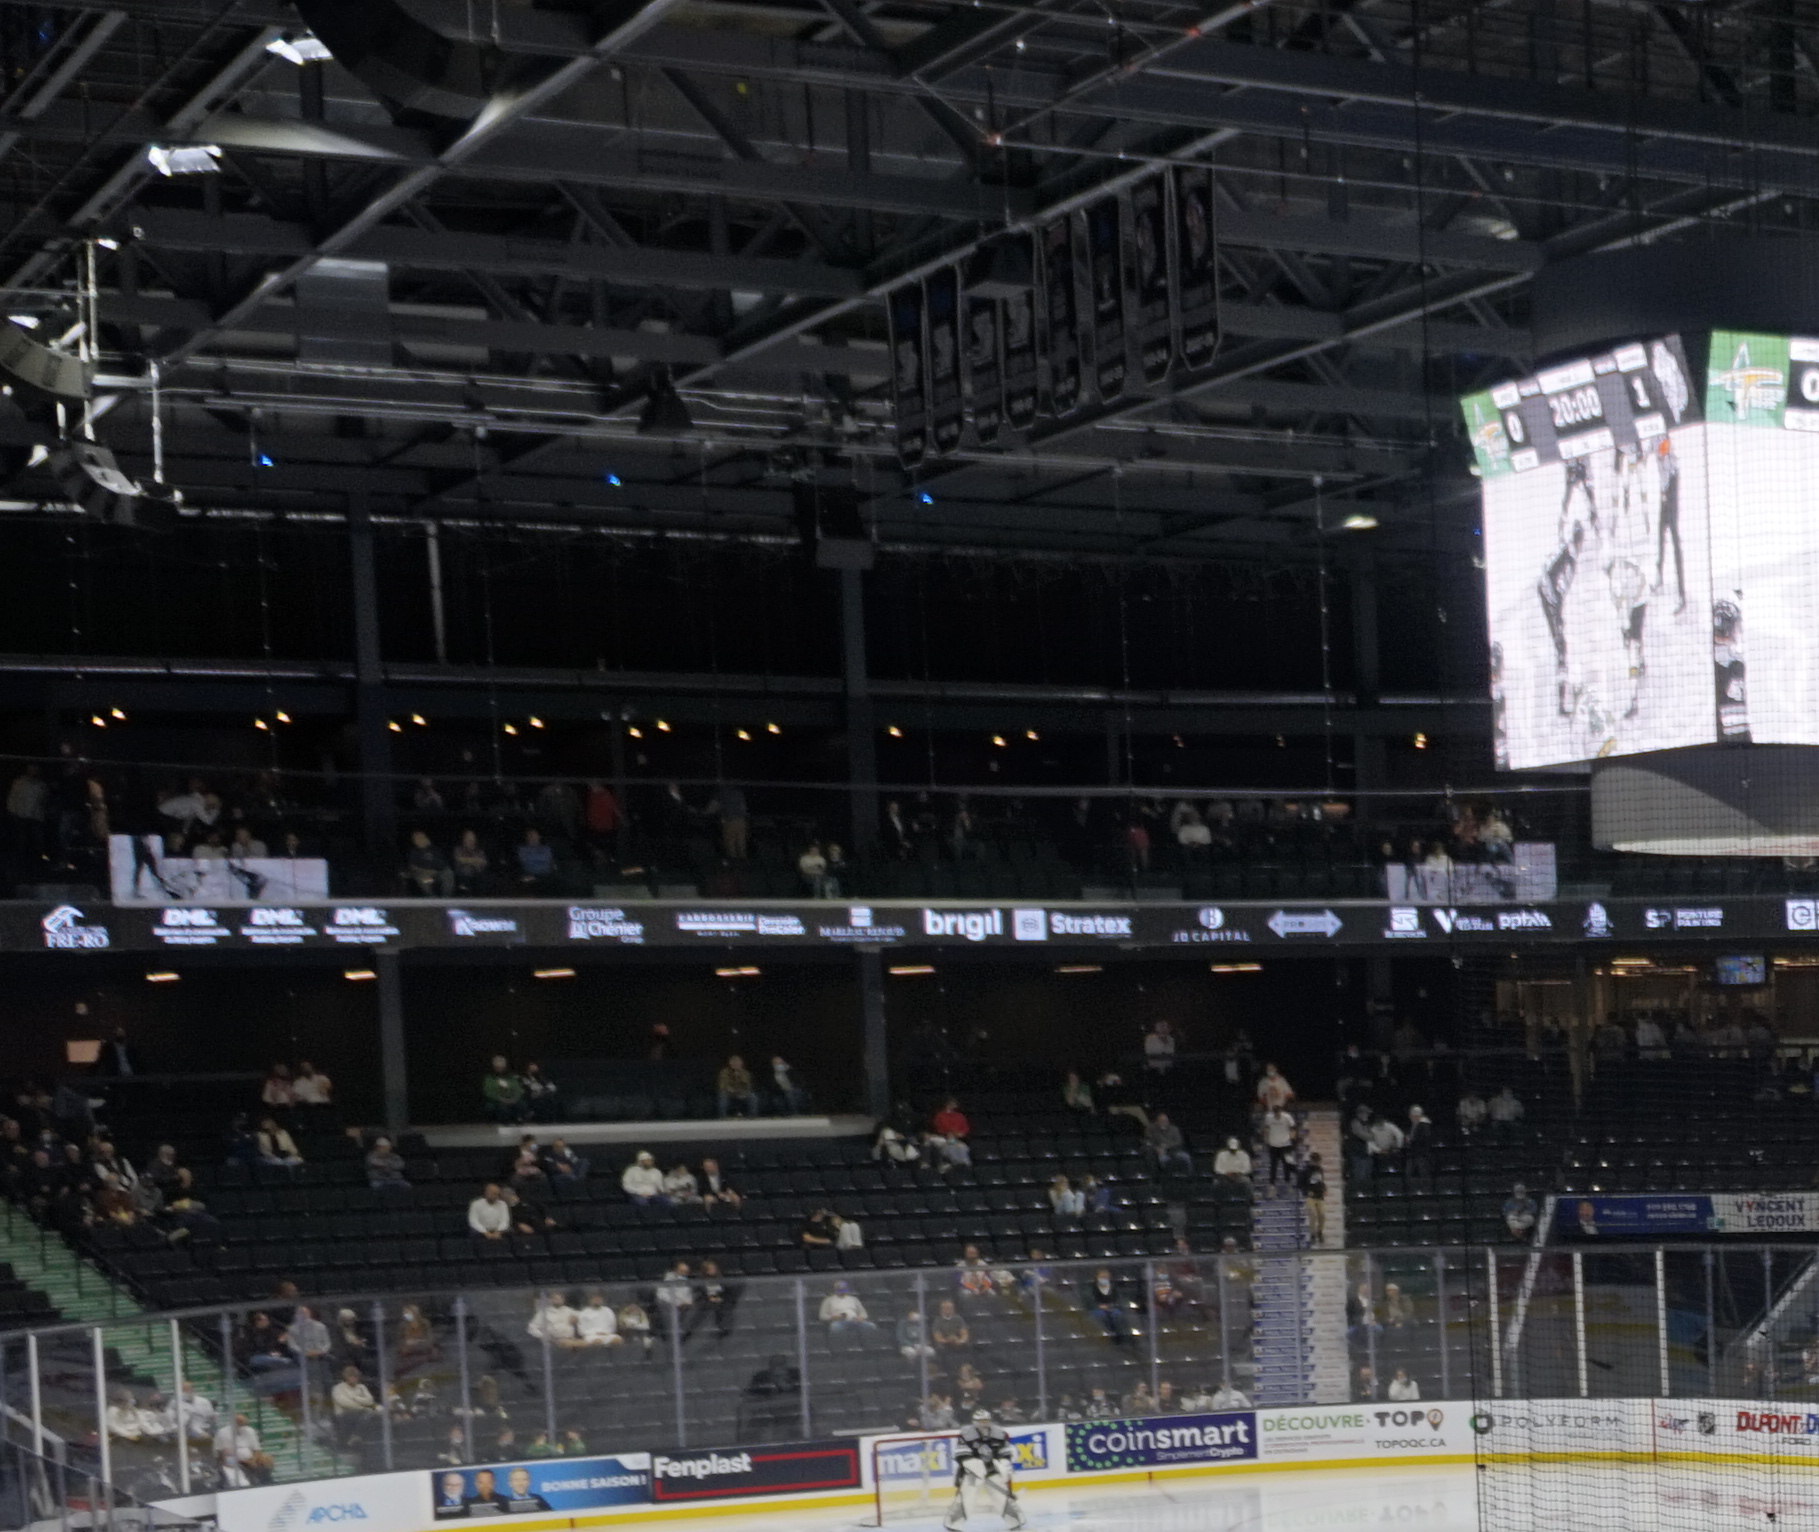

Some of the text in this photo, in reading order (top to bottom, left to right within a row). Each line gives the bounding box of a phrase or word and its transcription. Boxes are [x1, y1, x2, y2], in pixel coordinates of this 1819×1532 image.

[1632, 376, 1651, 408] 1
[1550, 386, 1602, 427] 20:00
[1505, 411, 1524, 443] 0
[568, 906, 624, 923] Groupe
[924, 909, 1003, 942] brigil
[1050, 913, 1133, 935] Stratex
[1191, 930, 1251, 943] CAPITAL
[1747, 1215, 1806, 1228] LEDOUX
[1262, 1414, 1365, 1433] DÉCOUVRE
[1500, 1415, 1619, 1428] POLYFORM
[1736, 1411, 1801, 1434] DUPONT
[1088, 1419, 1251, 1455] coinsmart
[653, 1452, 752, 1480] Fenplast
[878, 1442, 949, 1475] maxi
[541, 1479, 590, 1494] BONNE
[590, 1476, 639, 1491] SAISON
